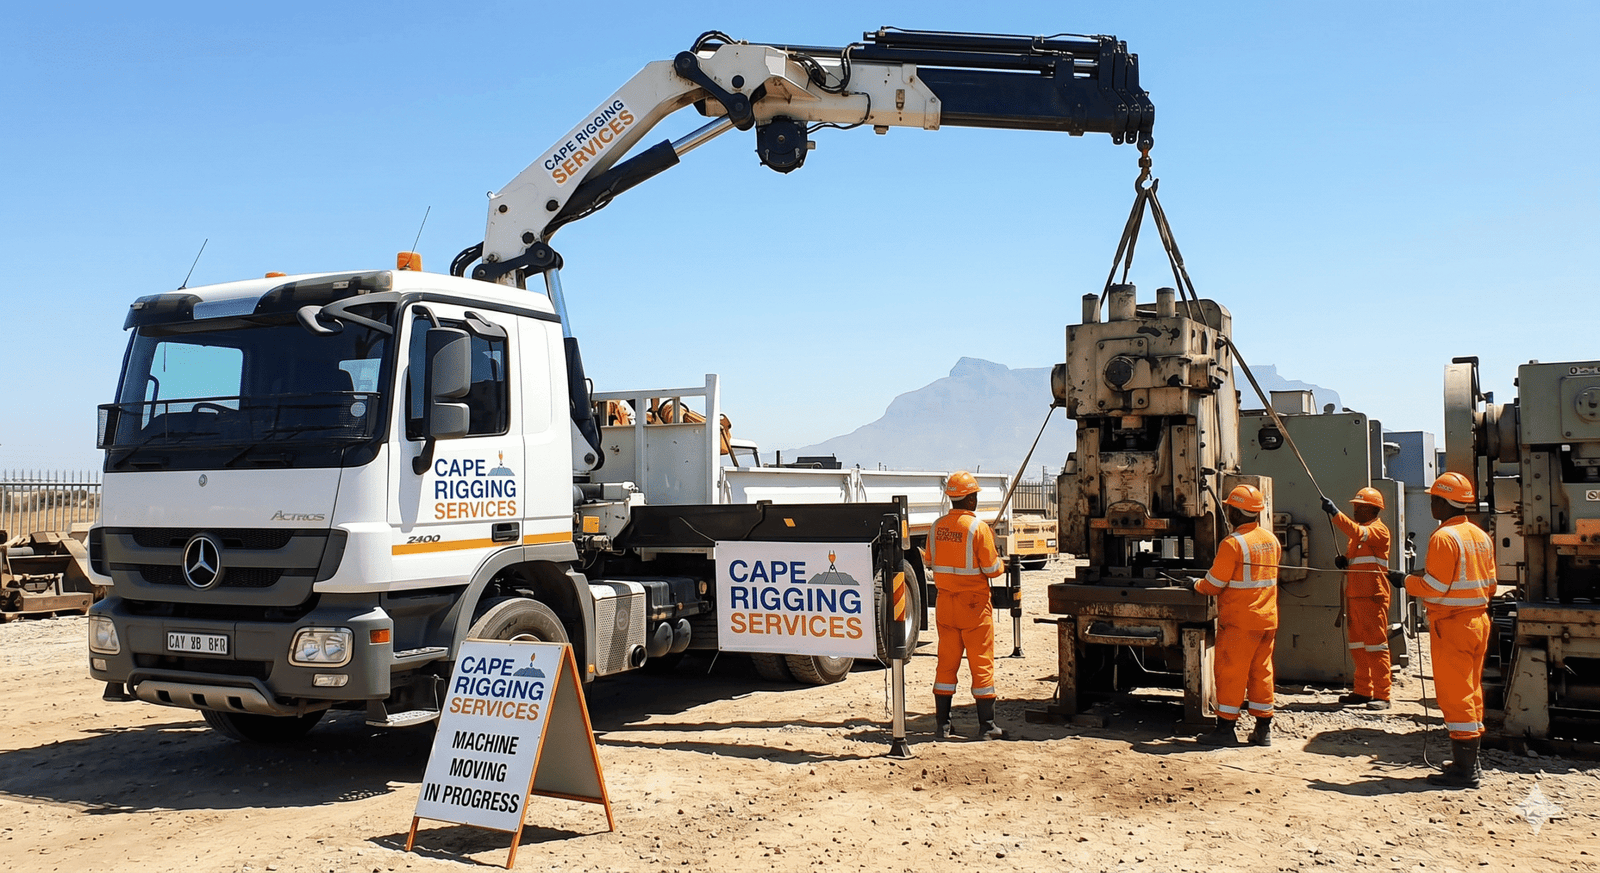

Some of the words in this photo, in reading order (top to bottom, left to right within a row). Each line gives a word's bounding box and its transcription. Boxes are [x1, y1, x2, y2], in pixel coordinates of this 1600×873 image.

[544, 140, 577, 170] CAPE
[575, 99, 625, 144] RIGGING
[552, 109, 635, 184] SERVICES
[434, 458, 486, 477] CAPE
[434, 479, 516, 500] RIGGING
[434, 500, 517, 520] SERVICES
[406, 534, 441, 544] 2400
[729, 559, 807, 584] CAPE
[730, 586, 862, 614] RIGGING
[730, 612, 863, 639] SERVICES
[169, 634, 186, 649] CAY
[461, 656, 515, 676] CAPE
[454, 676, 545, 701] RIGGING
[449, 697, 540, 721] SERVICES
[452, 730, 519, 755] MACHINE
[449, 758, 508, 783] MOVING
[424, 782, 441, 802] IN
[442, 785, 520, 814] PROGRESS
